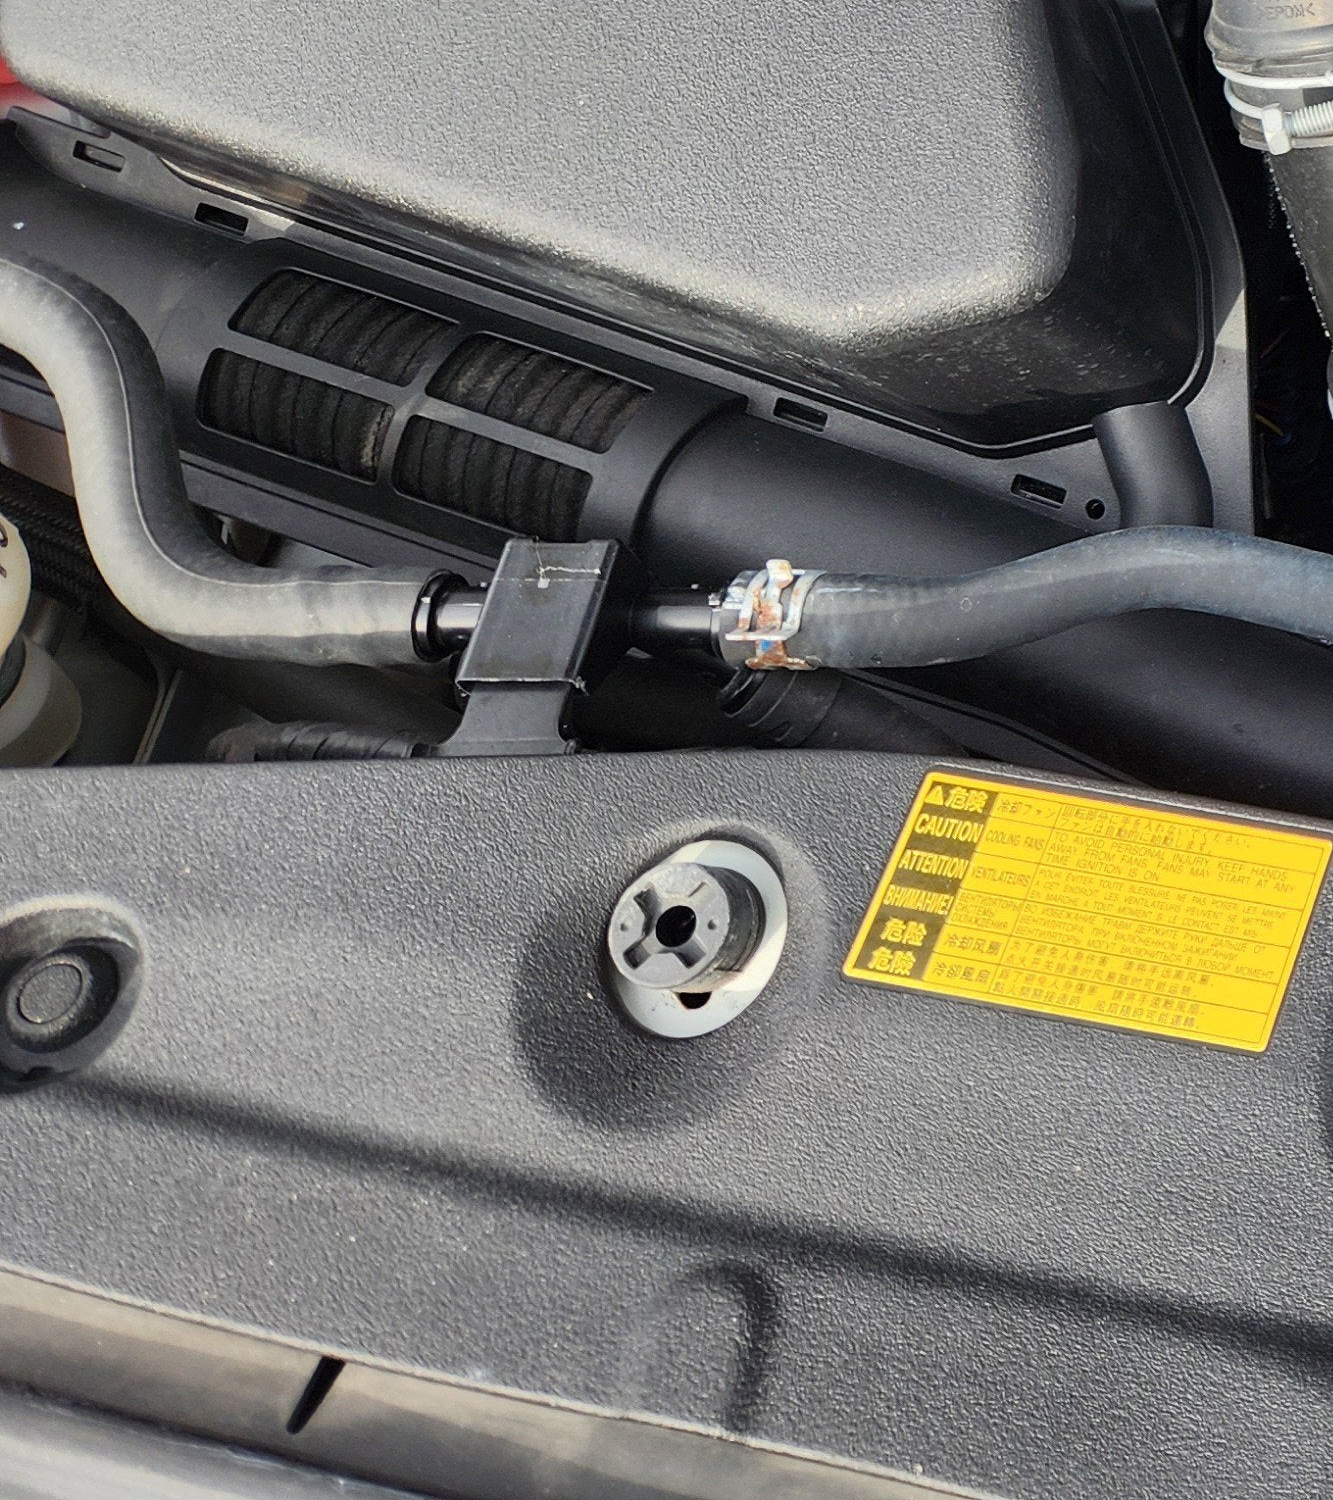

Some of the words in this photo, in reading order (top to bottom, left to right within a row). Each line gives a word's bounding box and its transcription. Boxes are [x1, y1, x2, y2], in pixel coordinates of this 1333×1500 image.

[943, 786, 990, 813] 危険
[912, 813, 984, 843] CAUTION
[983, 830, 1020, 846] COOLING
[1022, 836, 1045, 850] FANS
[897, 849, 968, 879] ATTENTION
[1044, 853, 1070, 866] TIME
[1074, 858, 1123, 875] IGNITION
[1048, 843, 1078, 856] AWAY
[1083, 849, 1115, 862] FROM
[1155, 861, 1184, 874] FANS
[1215, 871, 1250, 886] START
[1255, 878, 1268, 889] AT
[1053, 832, 1069, 843] TO
[1072, 835, 1105, 849] AVOID
[1109, 842, 1167, 861] PERSONAL
[1249, 866, 1289, 881] HANDS
[969, 865, 1031, 887] VENTILATEURS
[882, 884, 954, 915] ВНИМАНИЕ!
[878, 916, 930, 946] 危险
